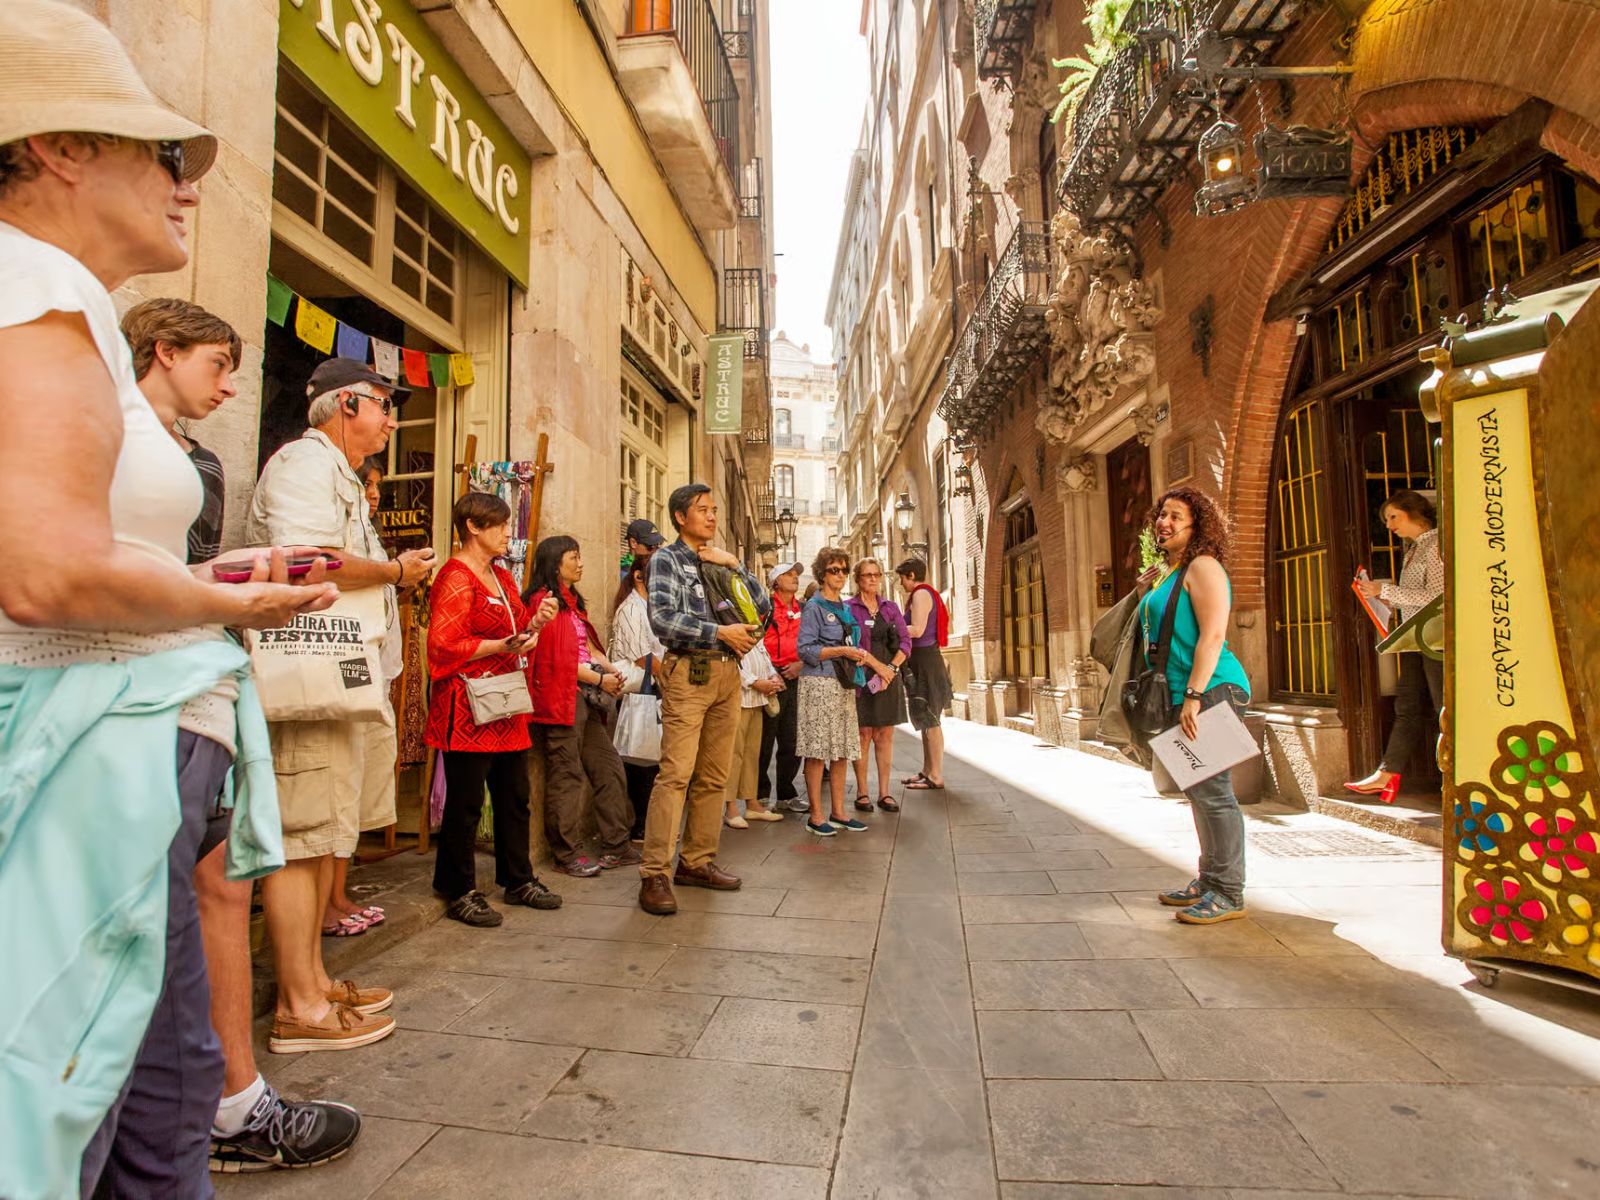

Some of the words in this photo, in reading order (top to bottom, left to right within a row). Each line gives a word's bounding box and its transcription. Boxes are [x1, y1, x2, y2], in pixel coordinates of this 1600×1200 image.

[715, 344, 733, 422] ASTRUC
[1477, 407, 1507, 552] MODERNISTA
[379, 509, 425, 527] TRUC
[260, 630, 363, 644] FESTIVAL
[285, 615, 328, 631] DEIRA
[331, 619, 361, 632] FILM
[1487, 560, 1519, 707] CERVESERIA
